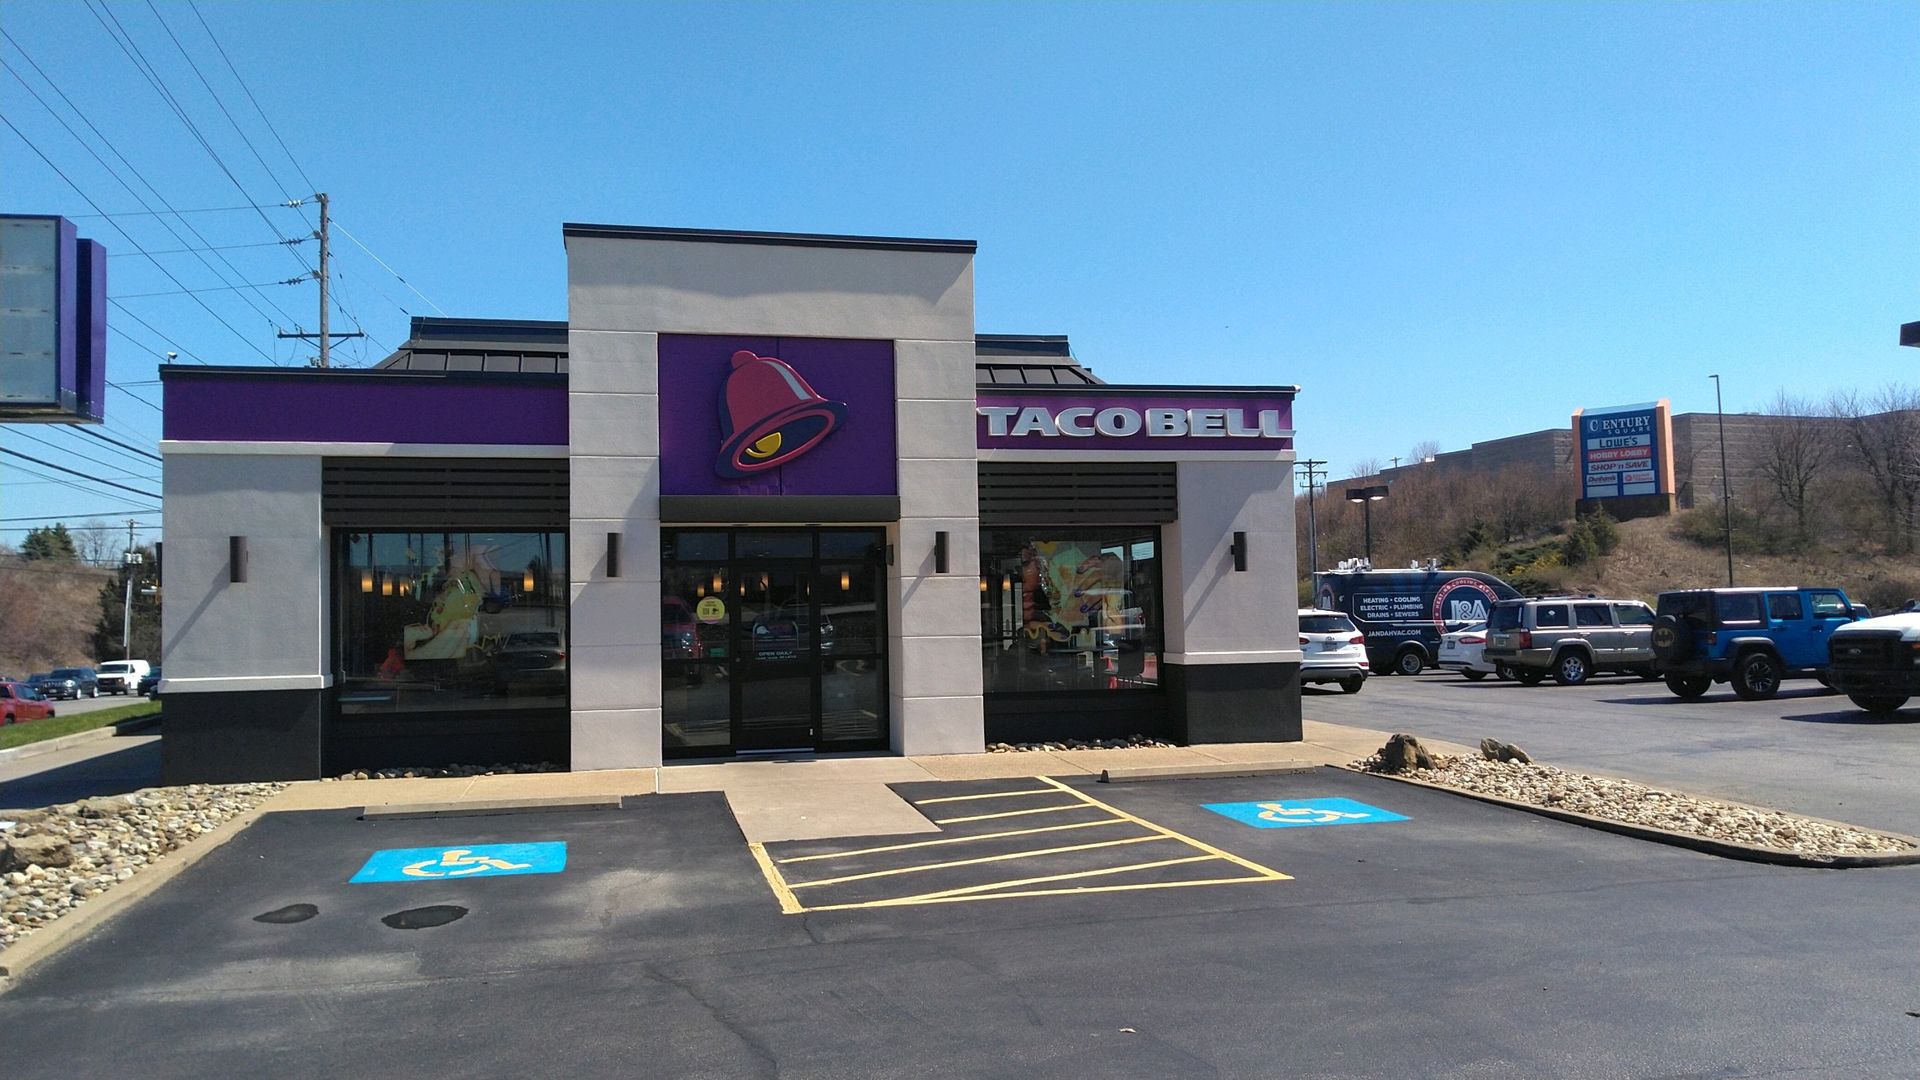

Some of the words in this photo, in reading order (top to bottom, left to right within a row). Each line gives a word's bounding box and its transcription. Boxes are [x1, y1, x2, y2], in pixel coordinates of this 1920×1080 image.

[977, 407, 1142, 437] TACO
[1145, 408, 1297, 438] BELL
[1590, 416, 1650, 432] CENTURY
[1607, 425, 1651, 435] SQUARE
[1599, 437, 1638, 448] LOWE'S
[1590, 451, 1619, 460] HOBBY
[1620, 449, 1648, 457] LOBBY
[1590, 463, 1616, 472] SHOP
[1625, 460, 1649, 469] SAVE
[1367, 629, 1421, 637] JANDAHVAC.COM
